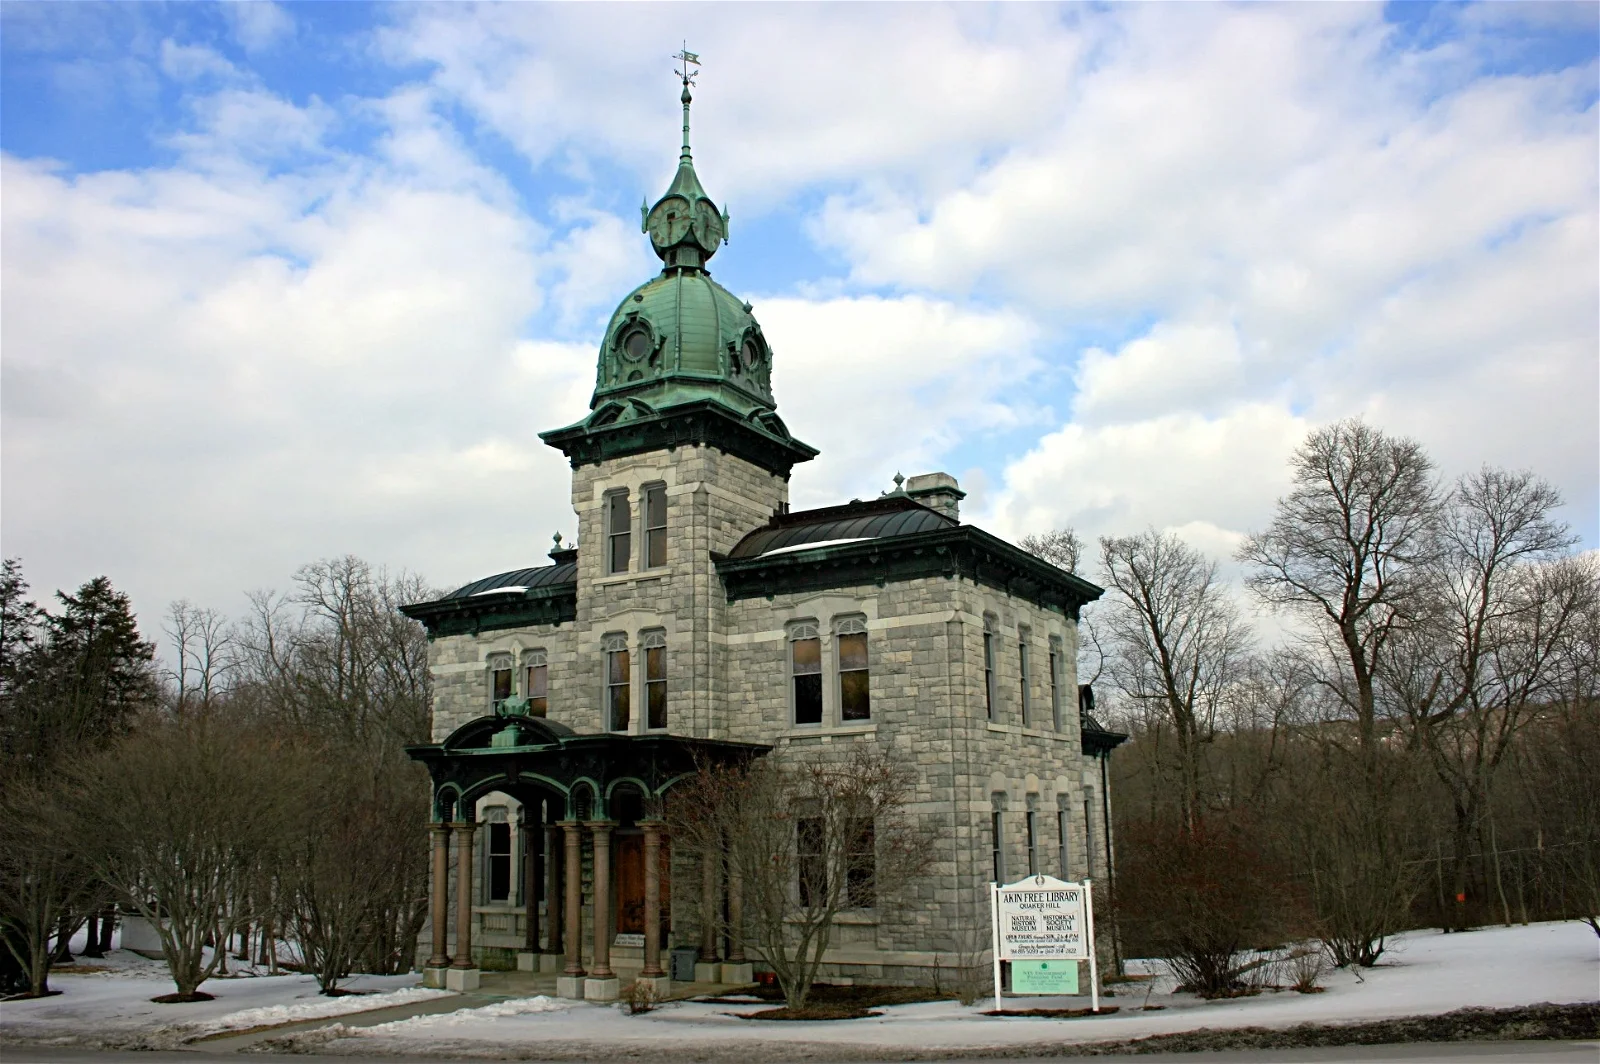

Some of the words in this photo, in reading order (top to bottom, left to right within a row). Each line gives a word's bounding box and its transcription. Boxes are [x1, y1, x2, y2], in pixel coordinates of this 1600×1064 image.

[1004, 893, 1023, 903] AKIN
[1024, 893, 1044, 902] FREE
[1047, 892, 1079, 902] LIBRARY
